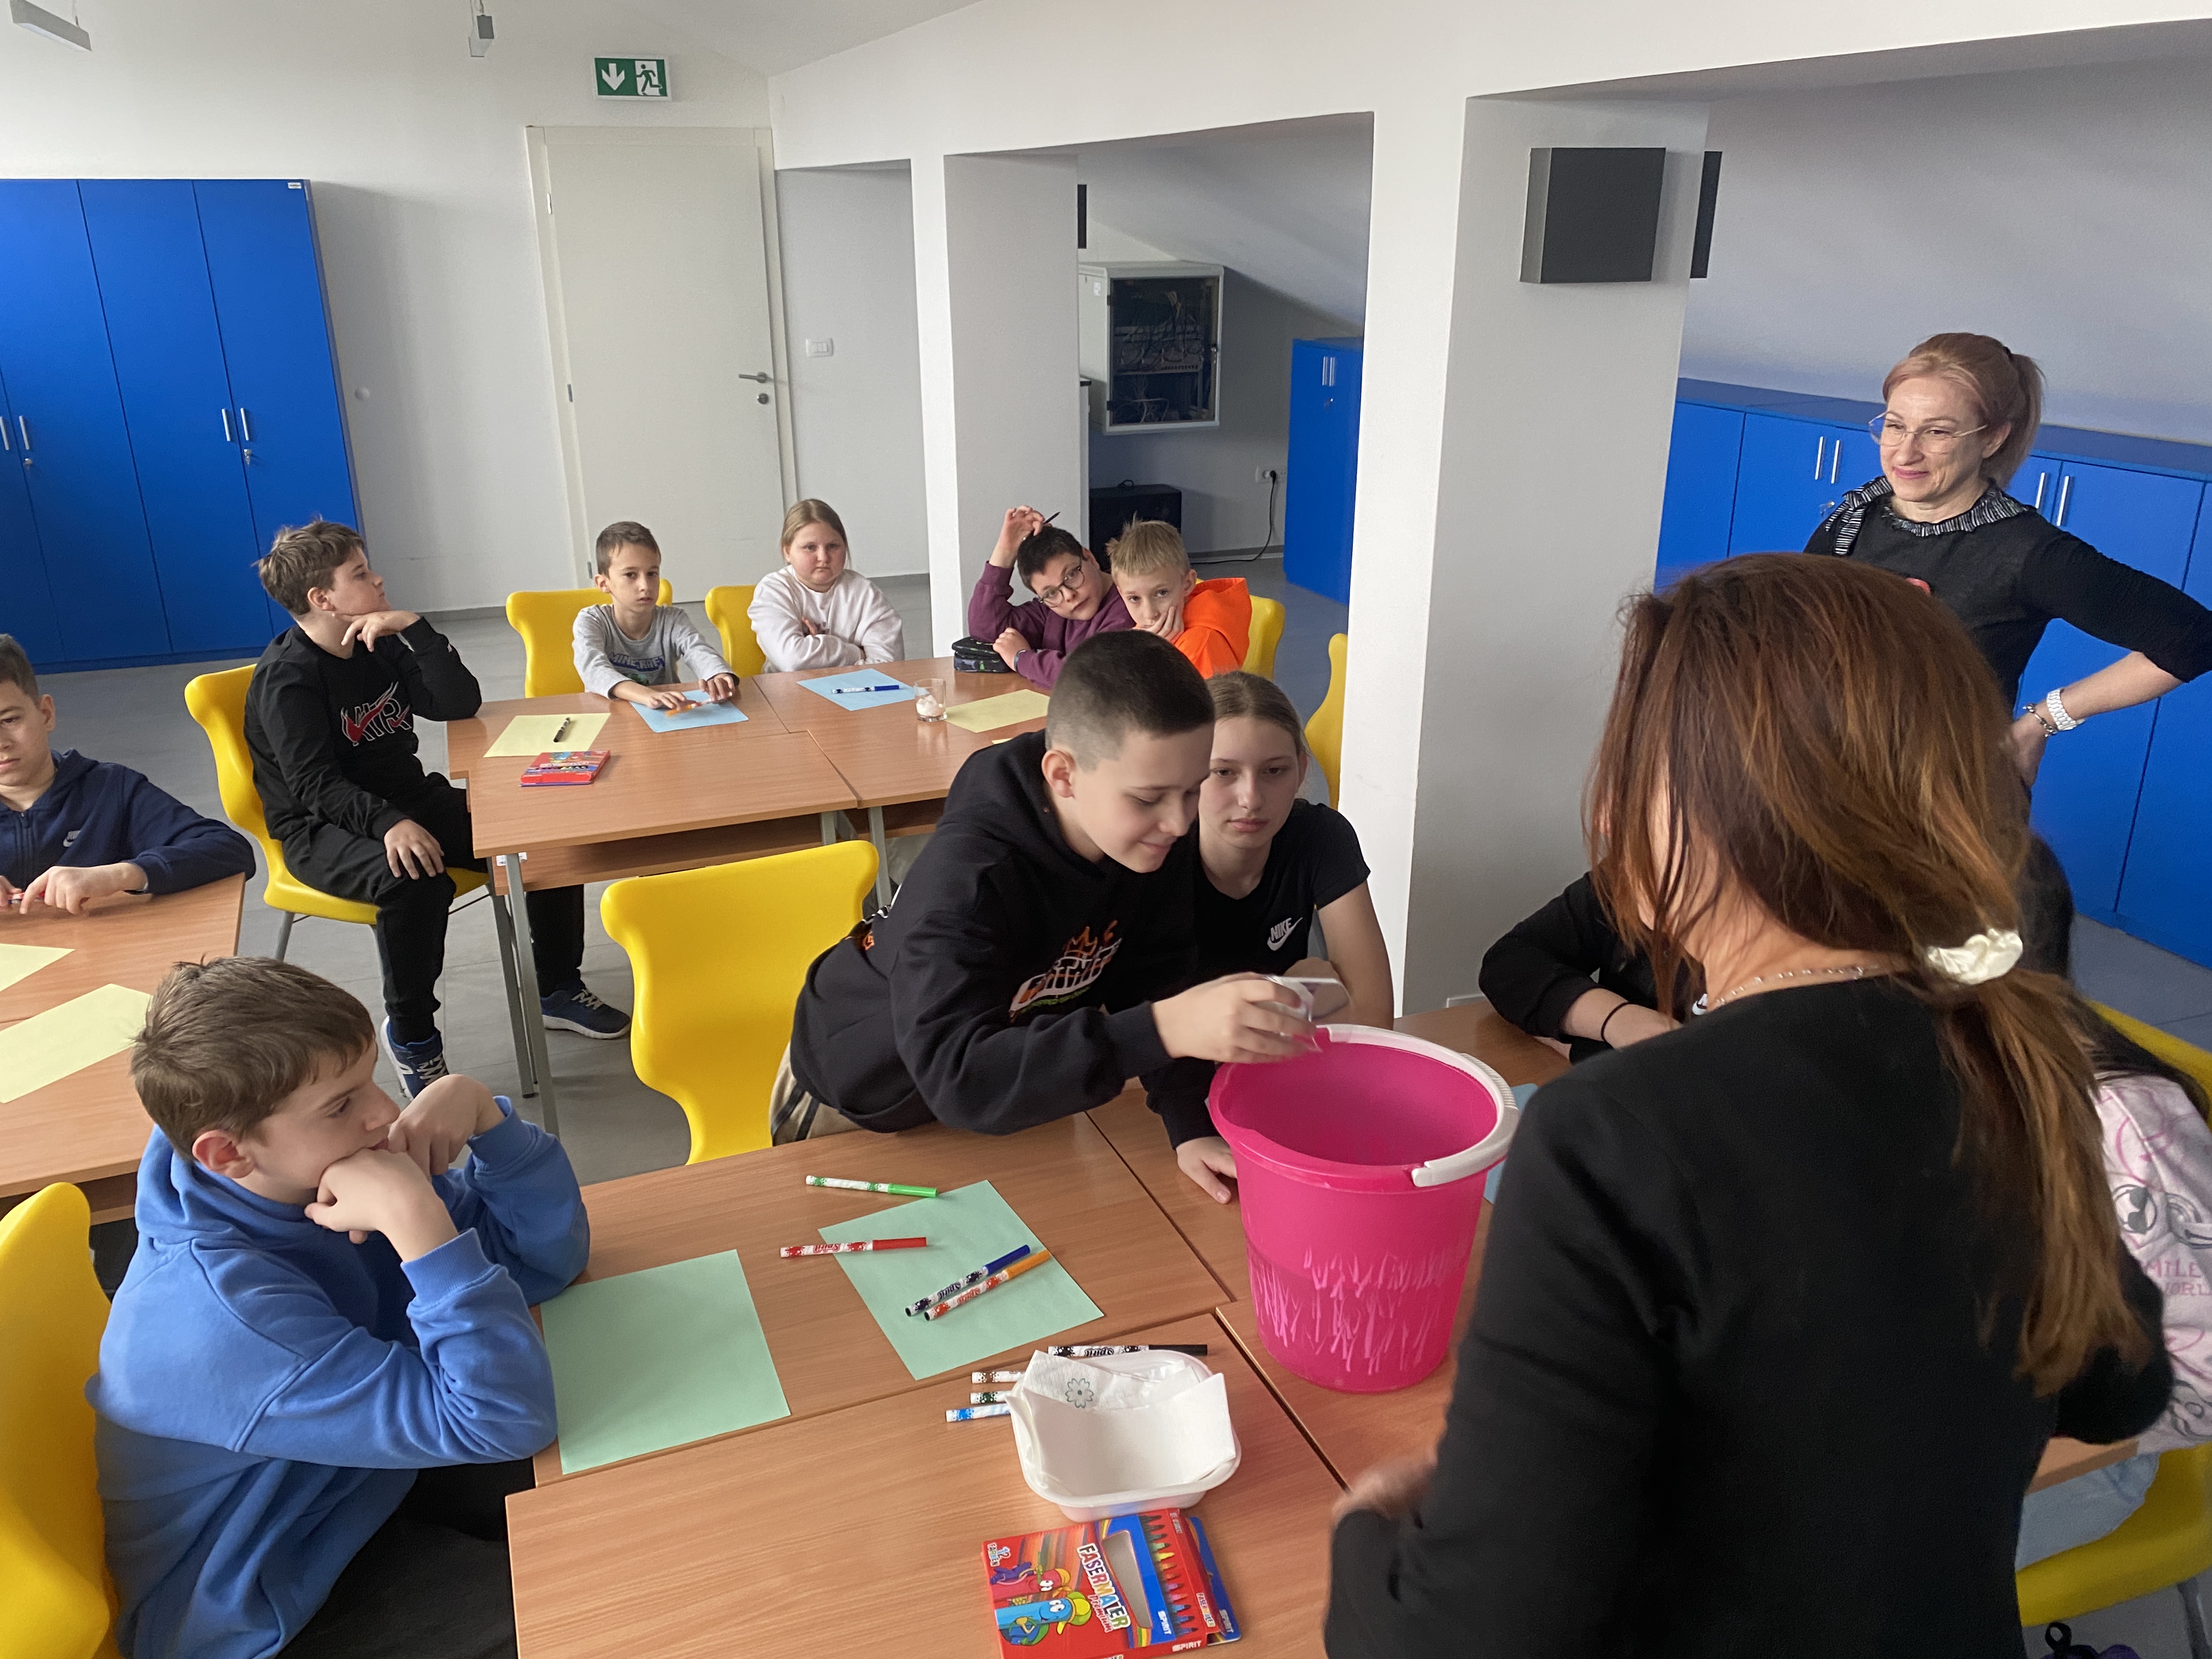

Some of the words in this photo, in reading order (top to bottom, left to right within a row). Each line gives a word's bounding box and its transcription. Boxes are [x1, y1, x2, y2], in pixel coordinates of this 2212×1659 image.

[1270, 917, 1292, 941] NIKE
[1077, 1543, 1131, 1629] FASERMALER
[1158, 1611, 1172, 1634] SPIRIT
[1172, 1640, 1202, 1652] SPIRIT
